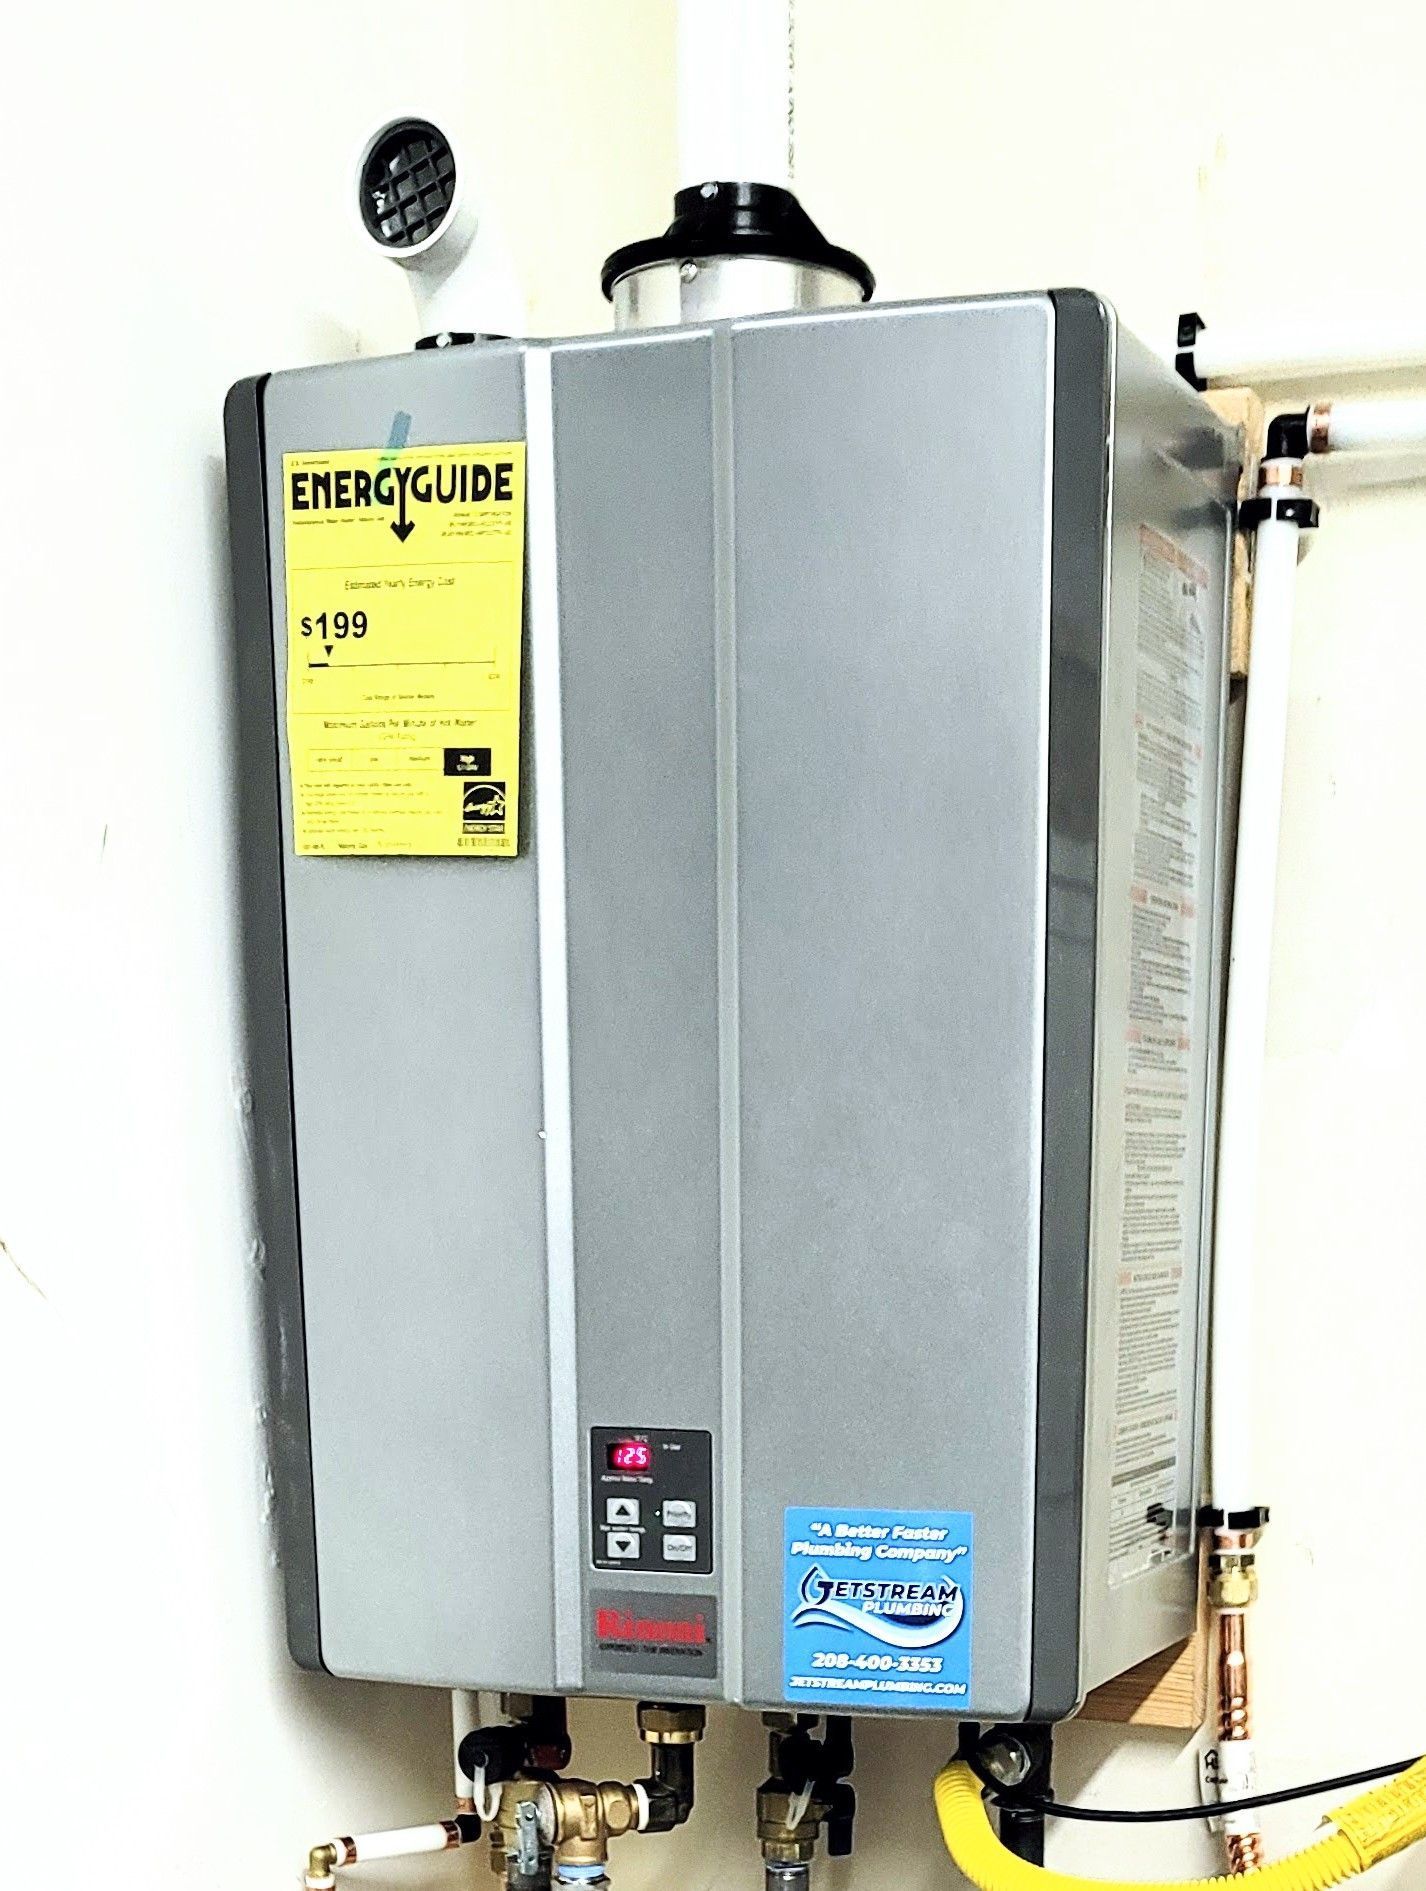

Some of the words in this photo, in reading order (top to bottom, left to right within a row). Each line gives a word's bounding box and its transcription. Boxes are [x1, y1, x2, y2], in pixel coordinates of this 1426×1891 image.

[291, 462, 514, 512] ENERGYGUIDE
[300, 610, 368, 640] $199
[617, 1446, 647, 1465] 125
[834, 1523, 890, 1540] Better
[891, 1525, 949, 1541] Faster
[791, 1541, 873, 1561] Plumbing
[817, 1580, 958, 1605] JETSTREAM
[861, 1600, 955, 1617] PLUMBING
